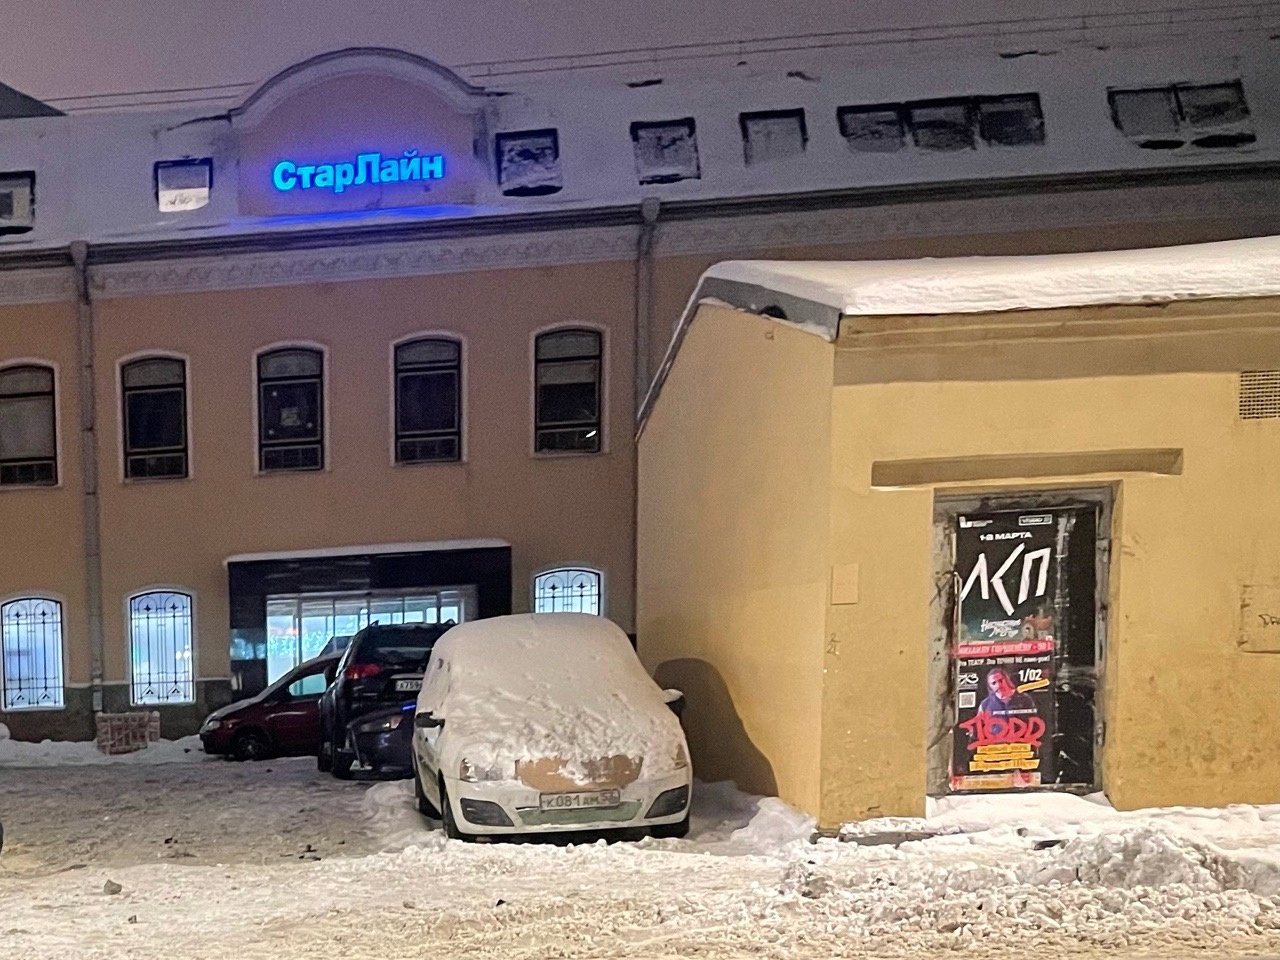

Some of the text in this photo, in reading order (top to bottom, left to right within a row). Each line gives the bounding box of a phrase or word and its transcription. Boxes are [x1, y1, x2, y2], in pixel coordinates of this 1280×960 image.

[273, 150, 443, 193] СтарЛайн
[995, 531, 1033, 540] МАРТА
[1018, 668, 1043, 682] 1/02
[399, 681, 422, 690] А759
